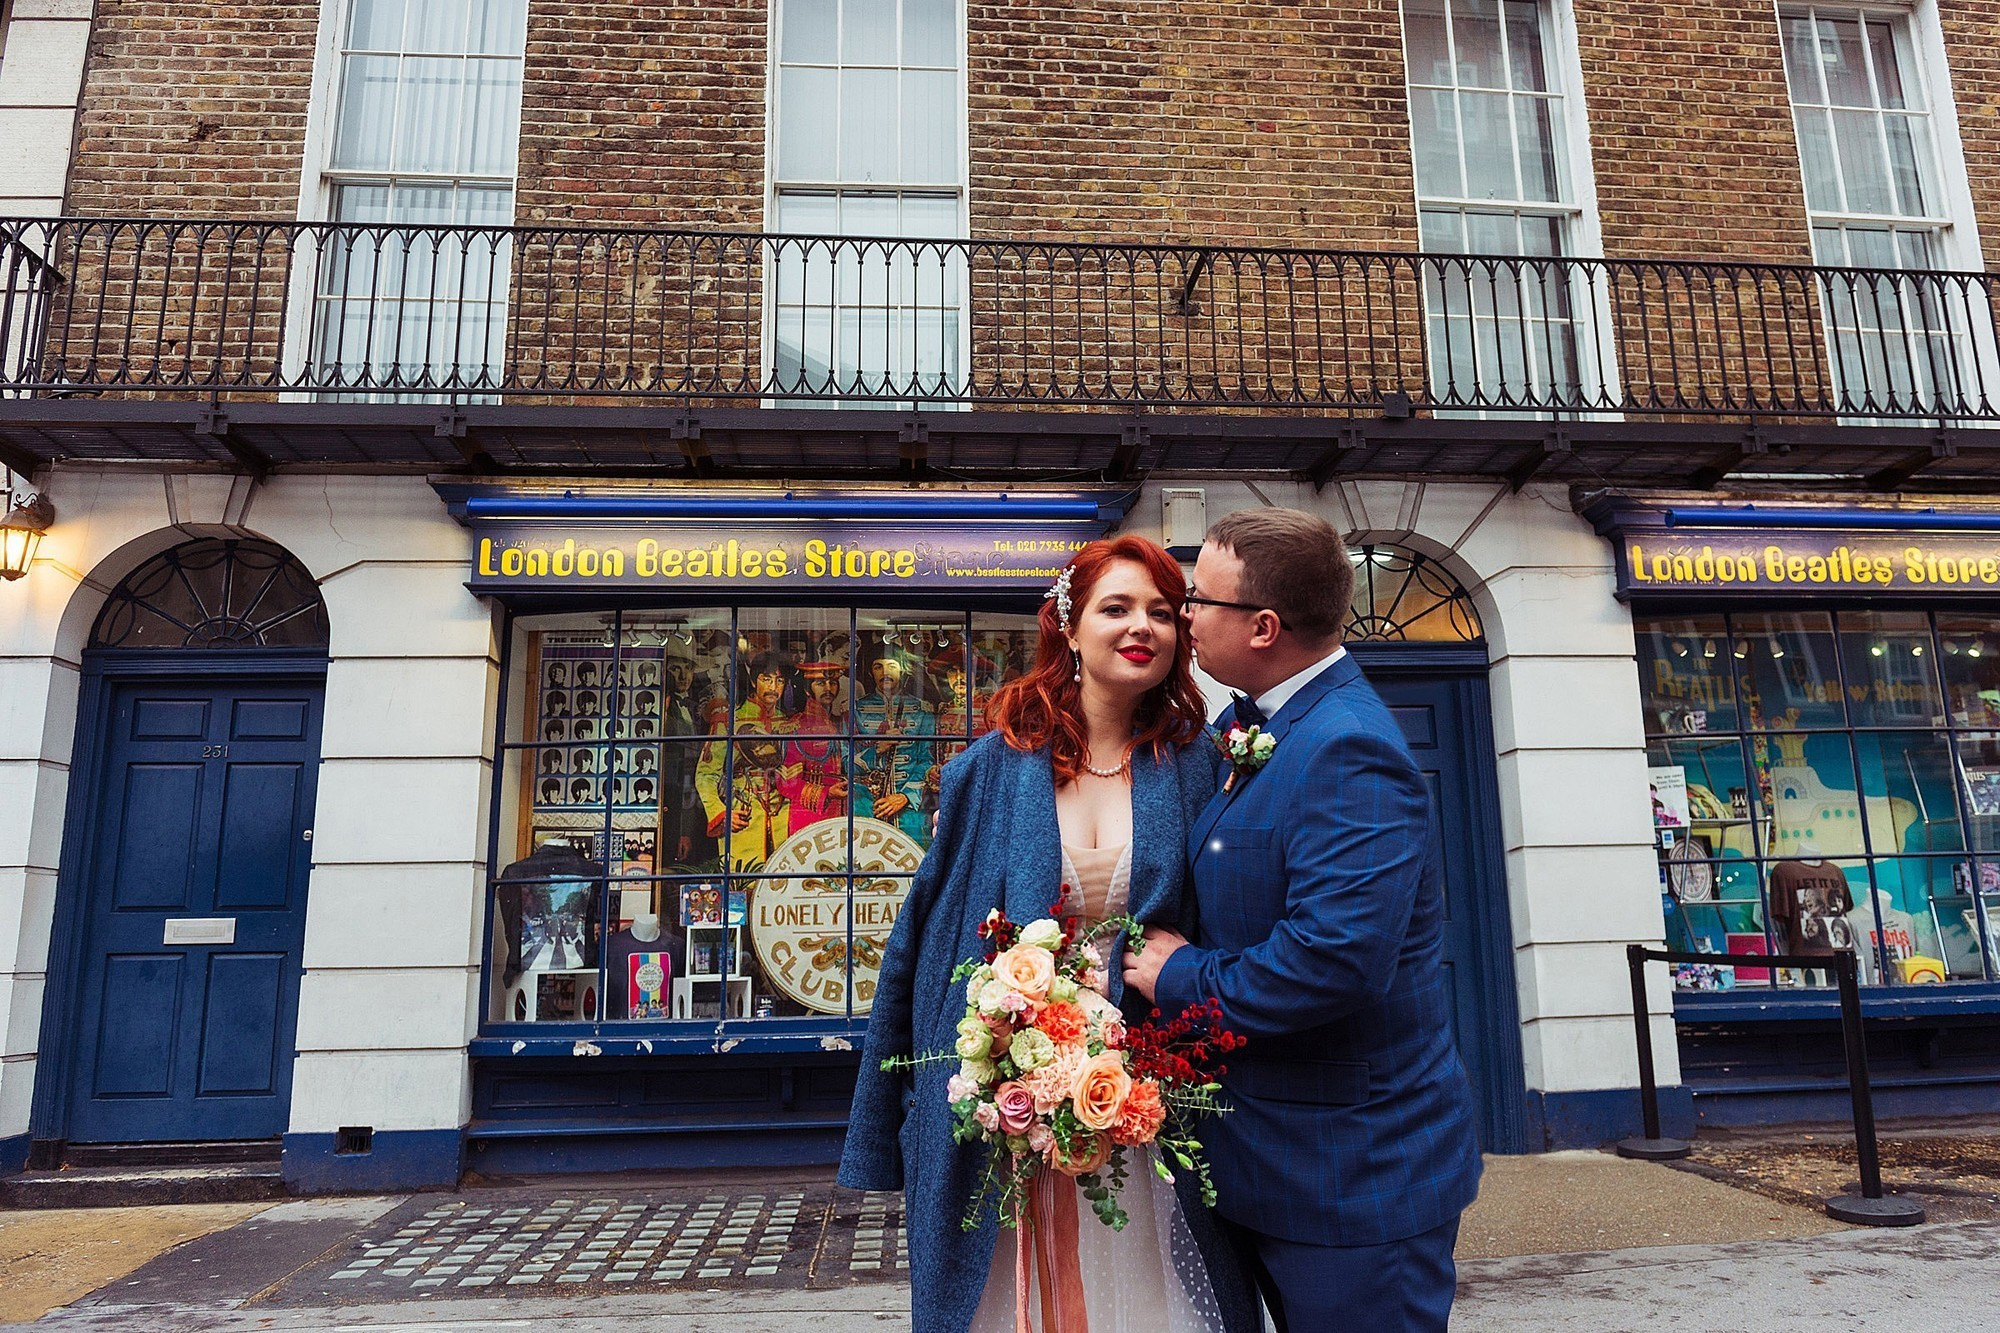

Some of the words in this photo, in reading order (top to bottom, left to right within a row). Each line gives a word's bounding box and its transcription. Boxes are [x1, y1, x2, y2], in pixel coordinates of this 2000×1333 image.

[479, 537, 624, 577] London
[636, 538, 787, 578] Beatles
[805, 539, 915, 578] Store
[993, 541, 1014, 551] Tel:
[1017, 541, 1036, 551] 020
[1039, 541, 1066, 551] 7935
[1632, 545, 1758, 582] London
[1764, 546, 1893, 583] Beatles
[1903, 547, 1999, 584] Store
[202, 745, 228, 758] 231
[760, 903, 845, 927] LONELY
[1869, 929, 1911, 949] BATLES
[771, 940, 845, 1003] CLUB
